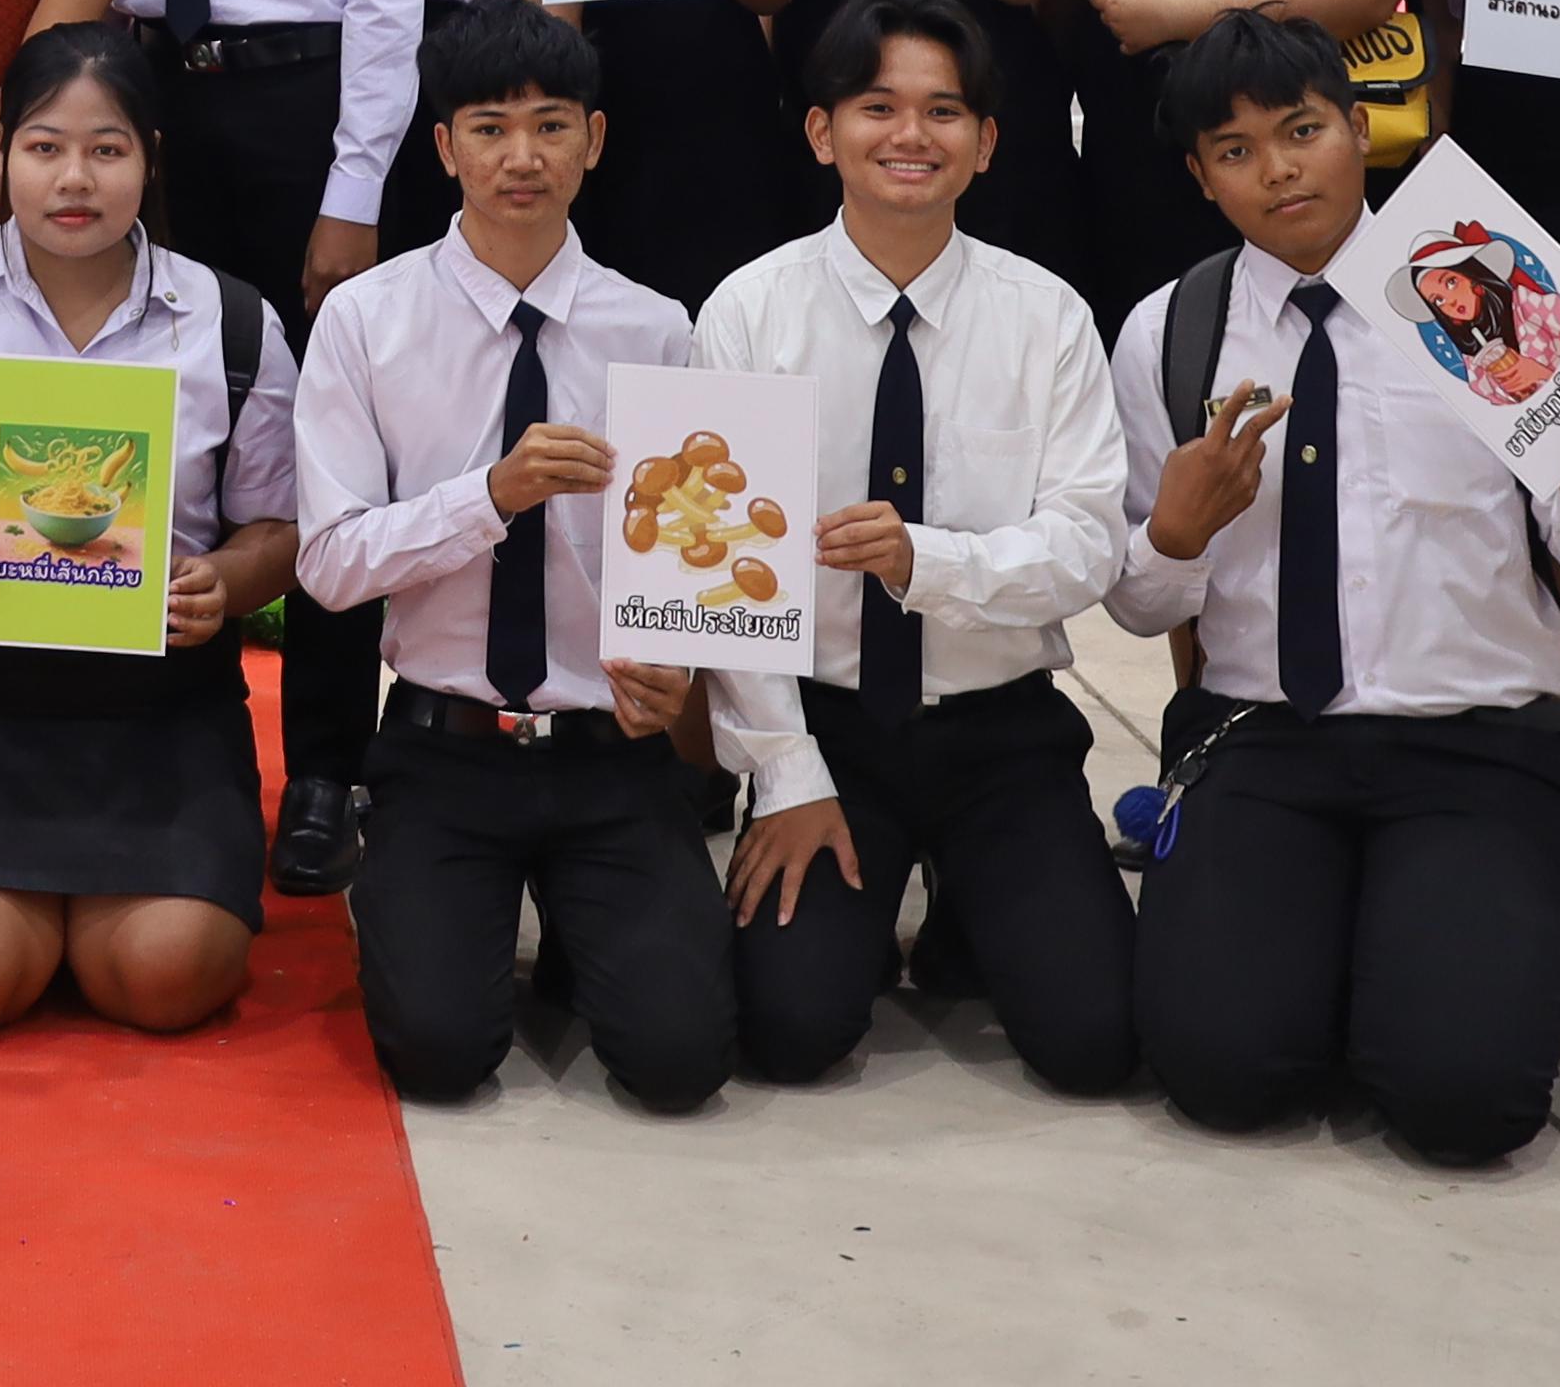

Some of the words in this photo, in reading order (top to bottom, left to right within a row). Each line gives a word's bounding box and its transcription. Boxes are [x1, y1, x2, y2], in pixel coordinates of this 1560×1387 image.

[615, 595, 802, 641] เห็ดมีประโยชน์
